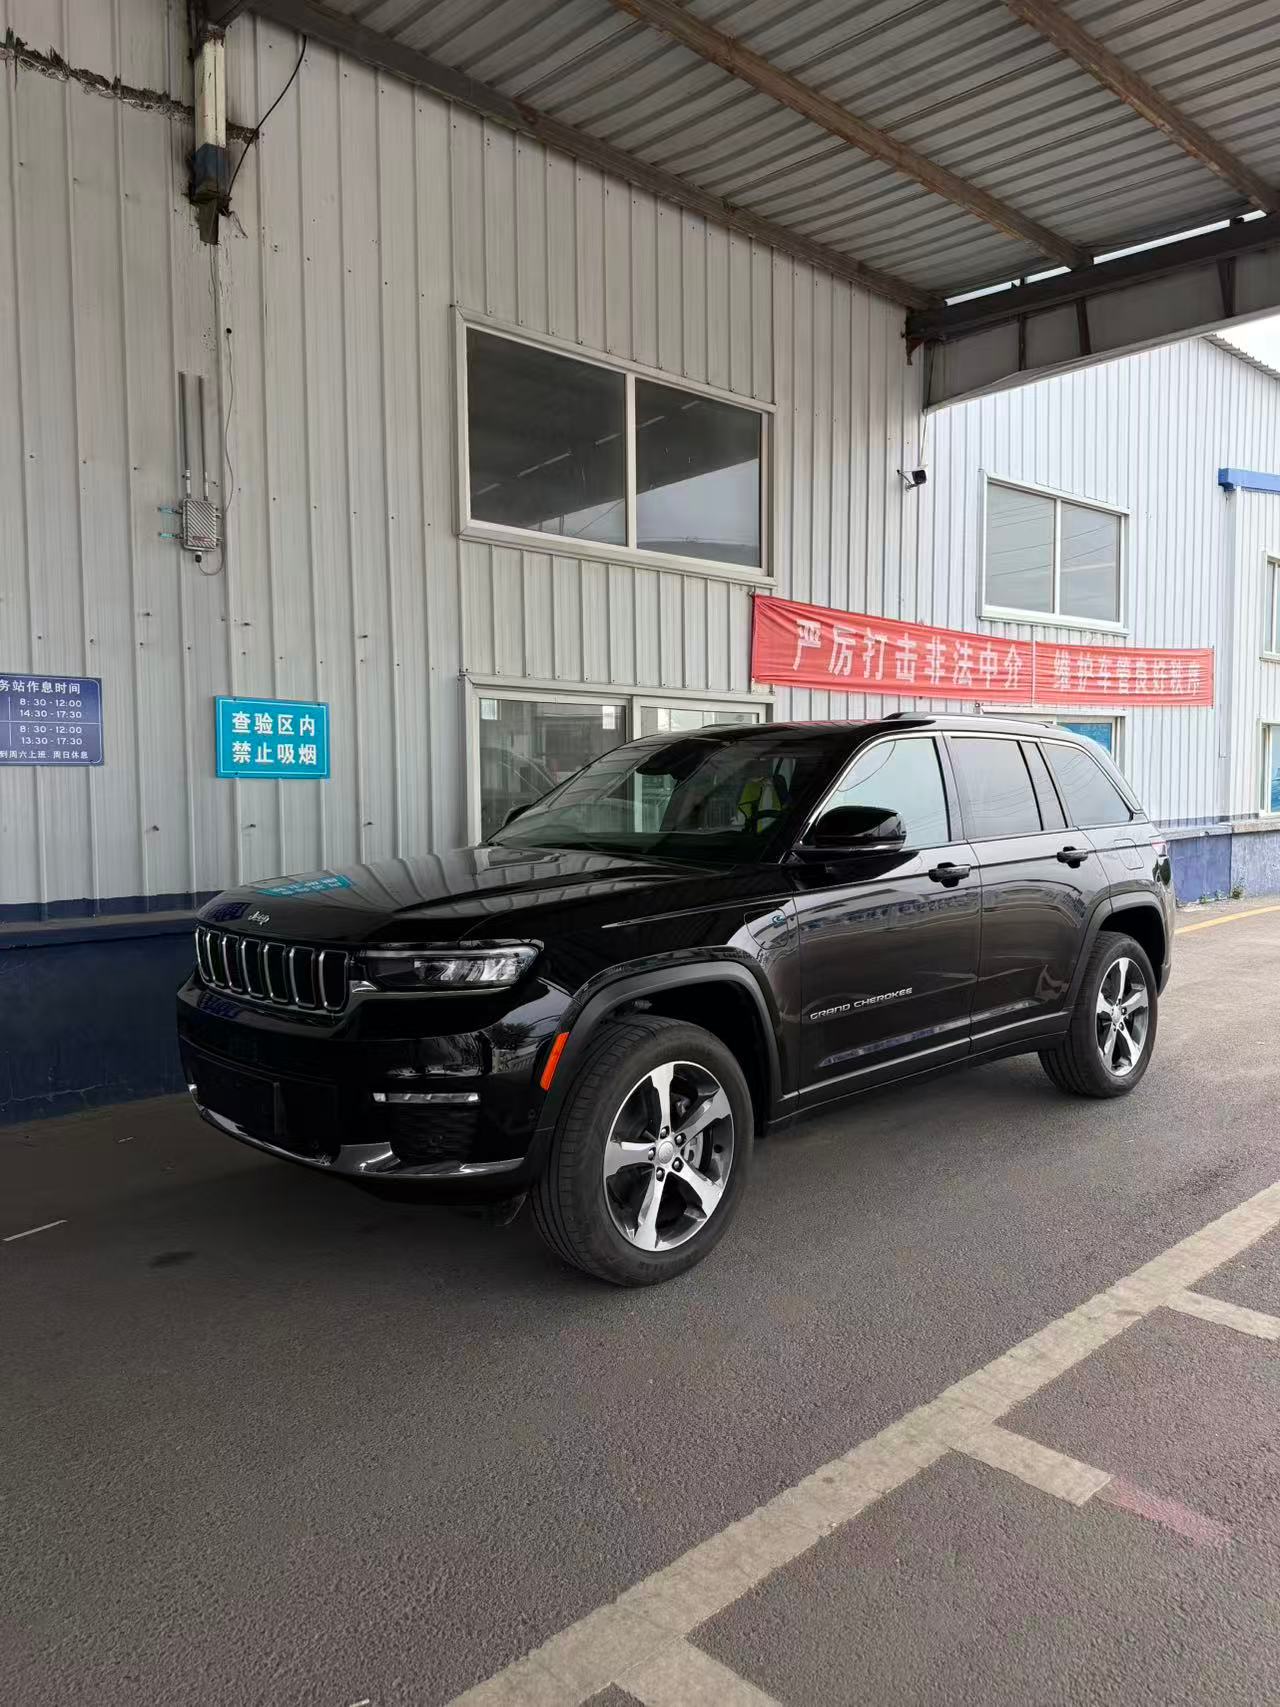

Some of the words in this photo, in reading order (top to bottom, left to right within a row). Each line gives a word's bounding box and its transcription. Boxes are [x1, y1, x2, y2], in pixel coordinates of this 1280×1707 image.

[792, 618, 1023, 689] 严厉打击非法中介
[231, 711, 316, 737] 查验区内
[232, 741, 317, 765] 禁止吸烟
[248, 911, 270, 926] Jeep
[810, 1003, 851, 1021] GRAND
[853, 987, 913, 1009] CHEROKEE
